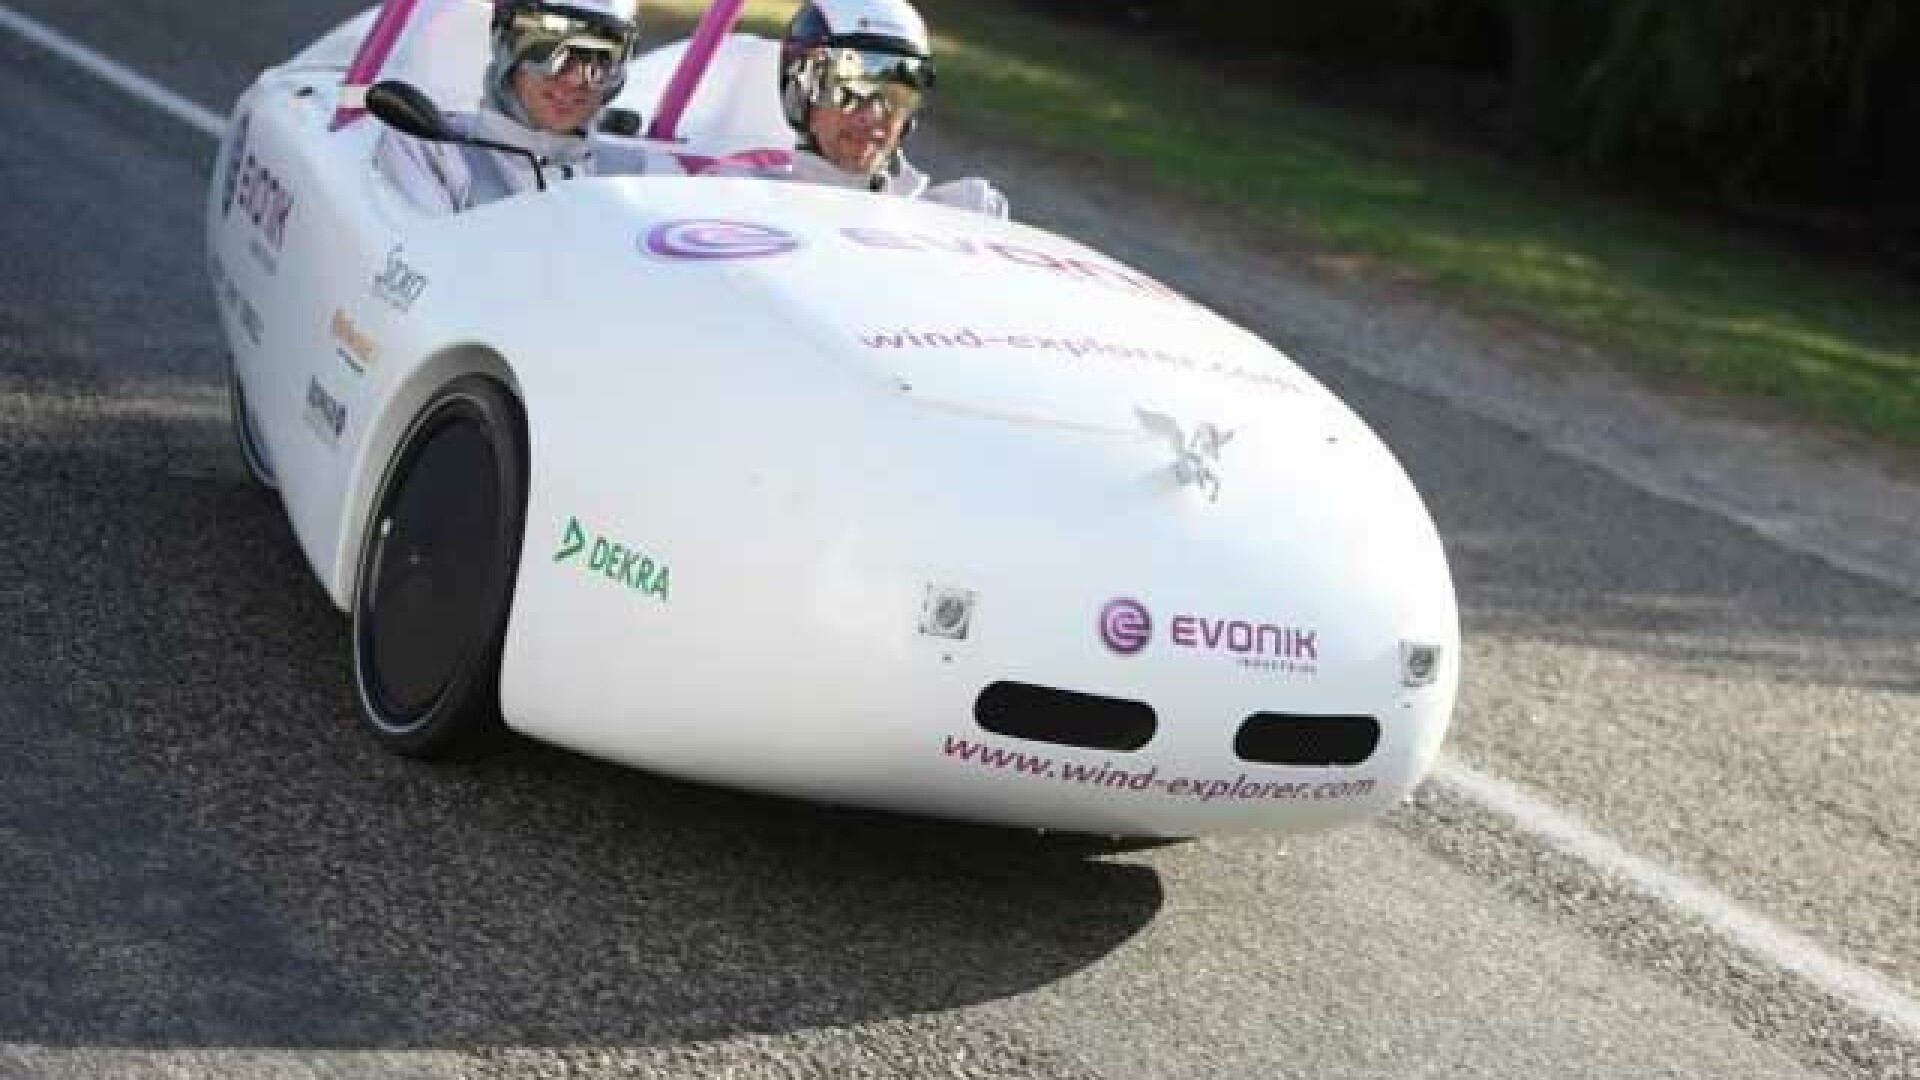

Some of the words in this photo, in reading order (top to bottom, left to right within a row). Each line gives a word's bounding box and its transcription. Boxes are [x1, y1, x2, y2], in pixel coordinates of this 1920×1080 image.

[588, 534, 671, 603] DEKRA
[1171, 613, 1318, 661] EVONIK
[943, 733, 1377, 801] www.wind-explorer.com
